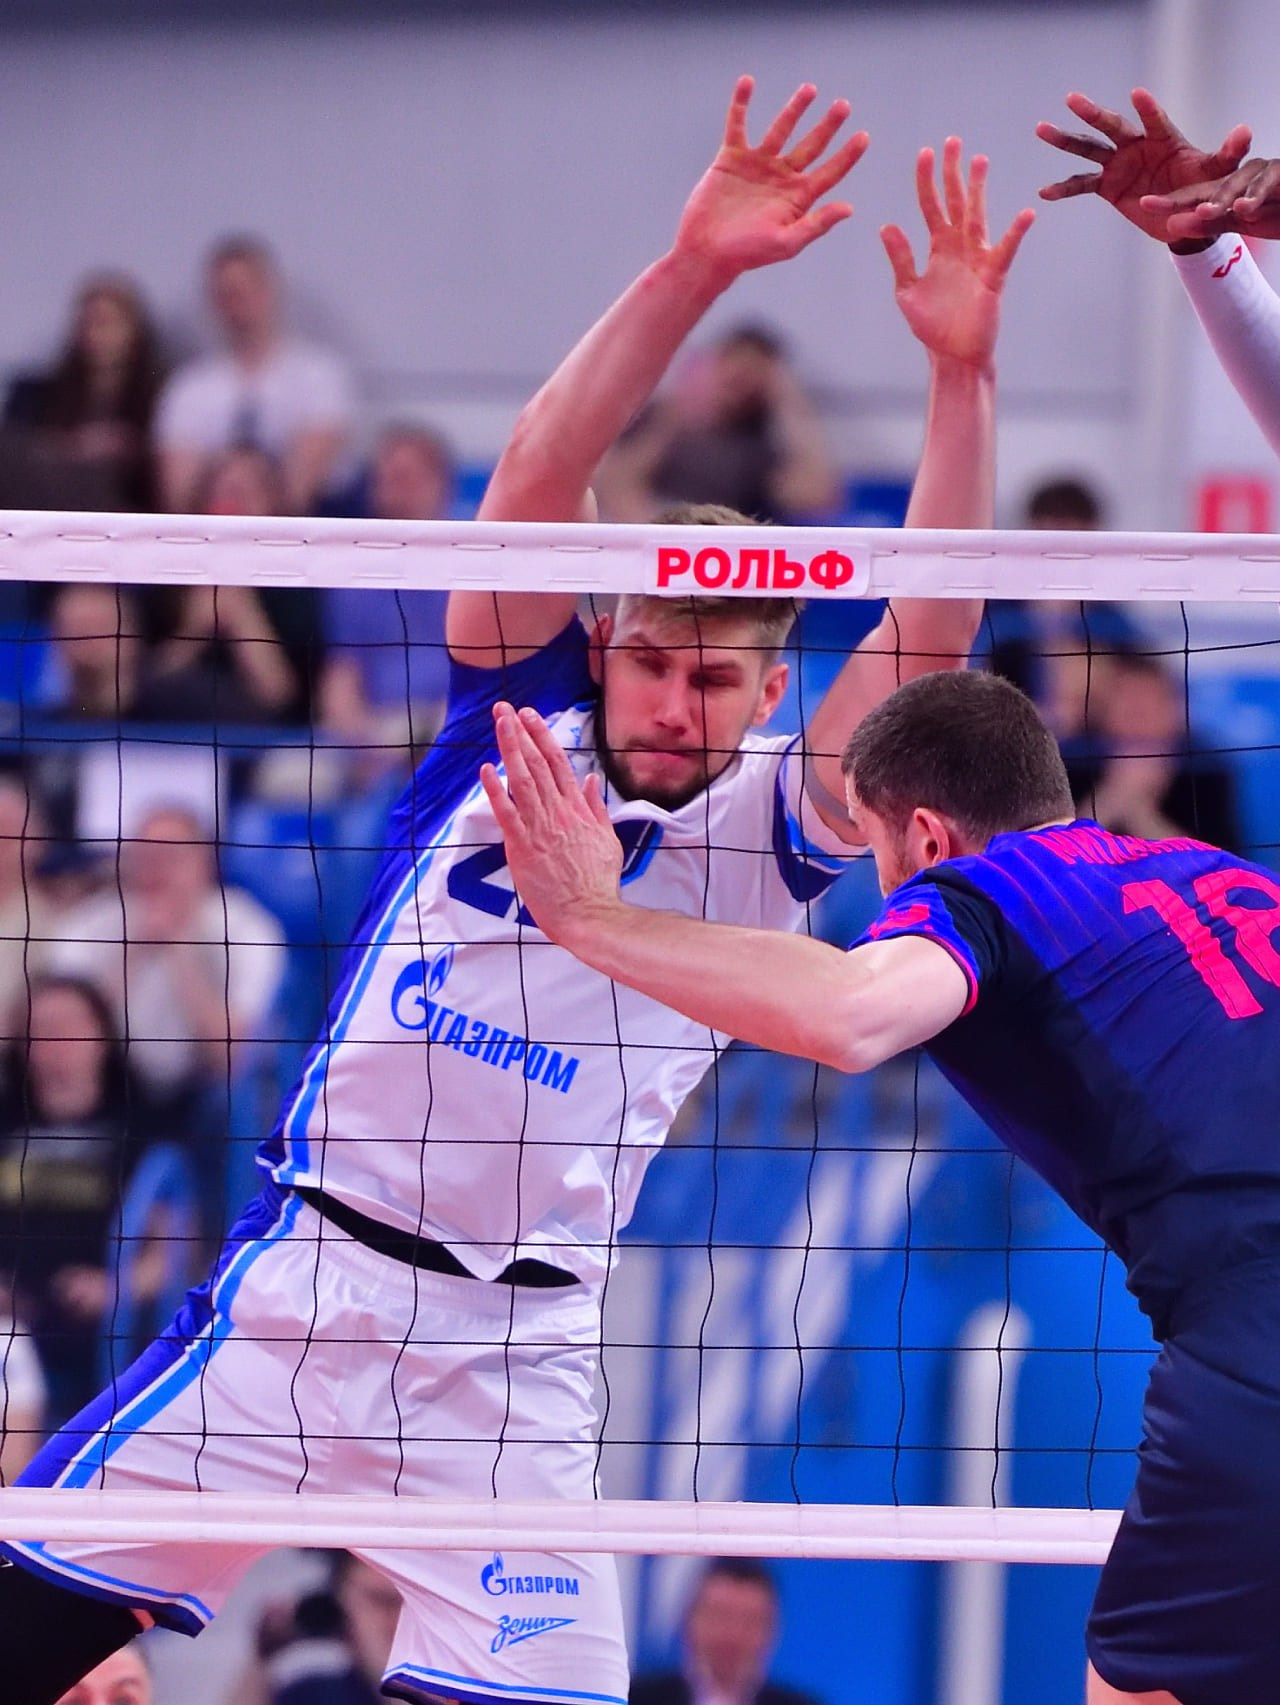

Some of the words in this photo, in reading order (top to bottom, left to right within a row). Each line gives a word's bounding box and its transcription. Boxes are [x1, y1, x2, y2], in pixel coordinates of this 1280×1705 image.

[656, 547, 855, 590] РОЛЬФ
[430, 1005, 580, 1094] ГАЗПРОМ
[508, 1576, 579, 1596] ГАЗПРОМ
